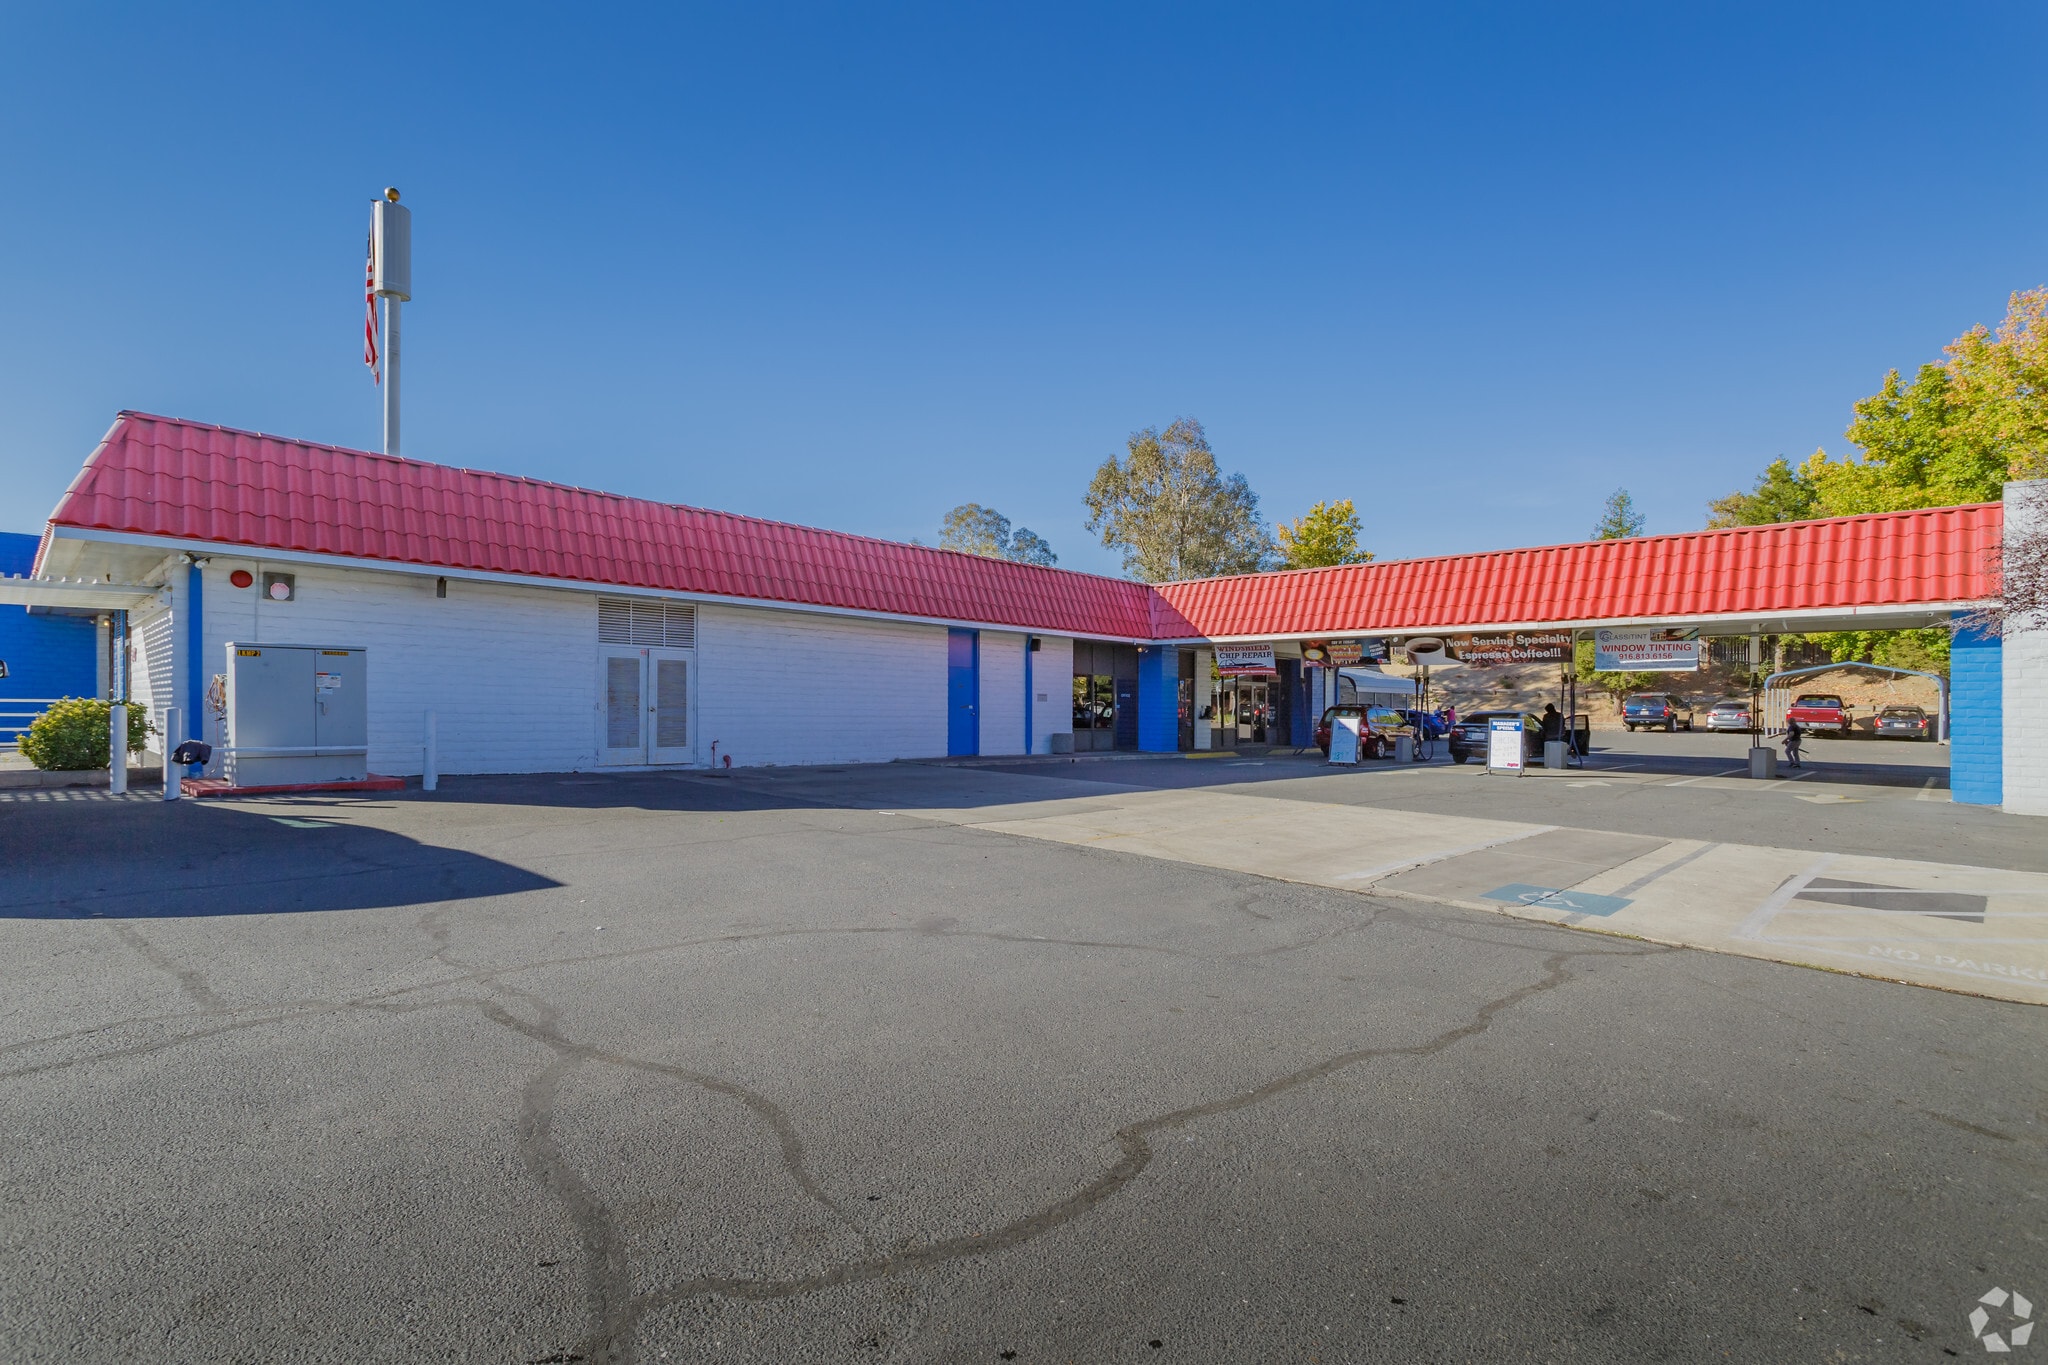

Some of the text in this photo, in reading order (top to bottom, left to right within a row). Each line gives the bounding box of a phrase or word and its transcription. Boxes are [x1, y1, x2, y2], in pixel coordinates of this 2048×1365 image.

[1446, 634, 1571, 648] Now Serving Specialty
[1217, 644, 1270, 652] WINDSHIELD
[1602, 643, 1692, 652] WINDOW TINTING
[1242, 651, 1273, 659] REPAIR
[1458, 648, 1561, 661] Espresso Coffee!!!
[1618, 652, 1673, 660] 916.813.6156
[1868, 945, 1920, 961] NO
